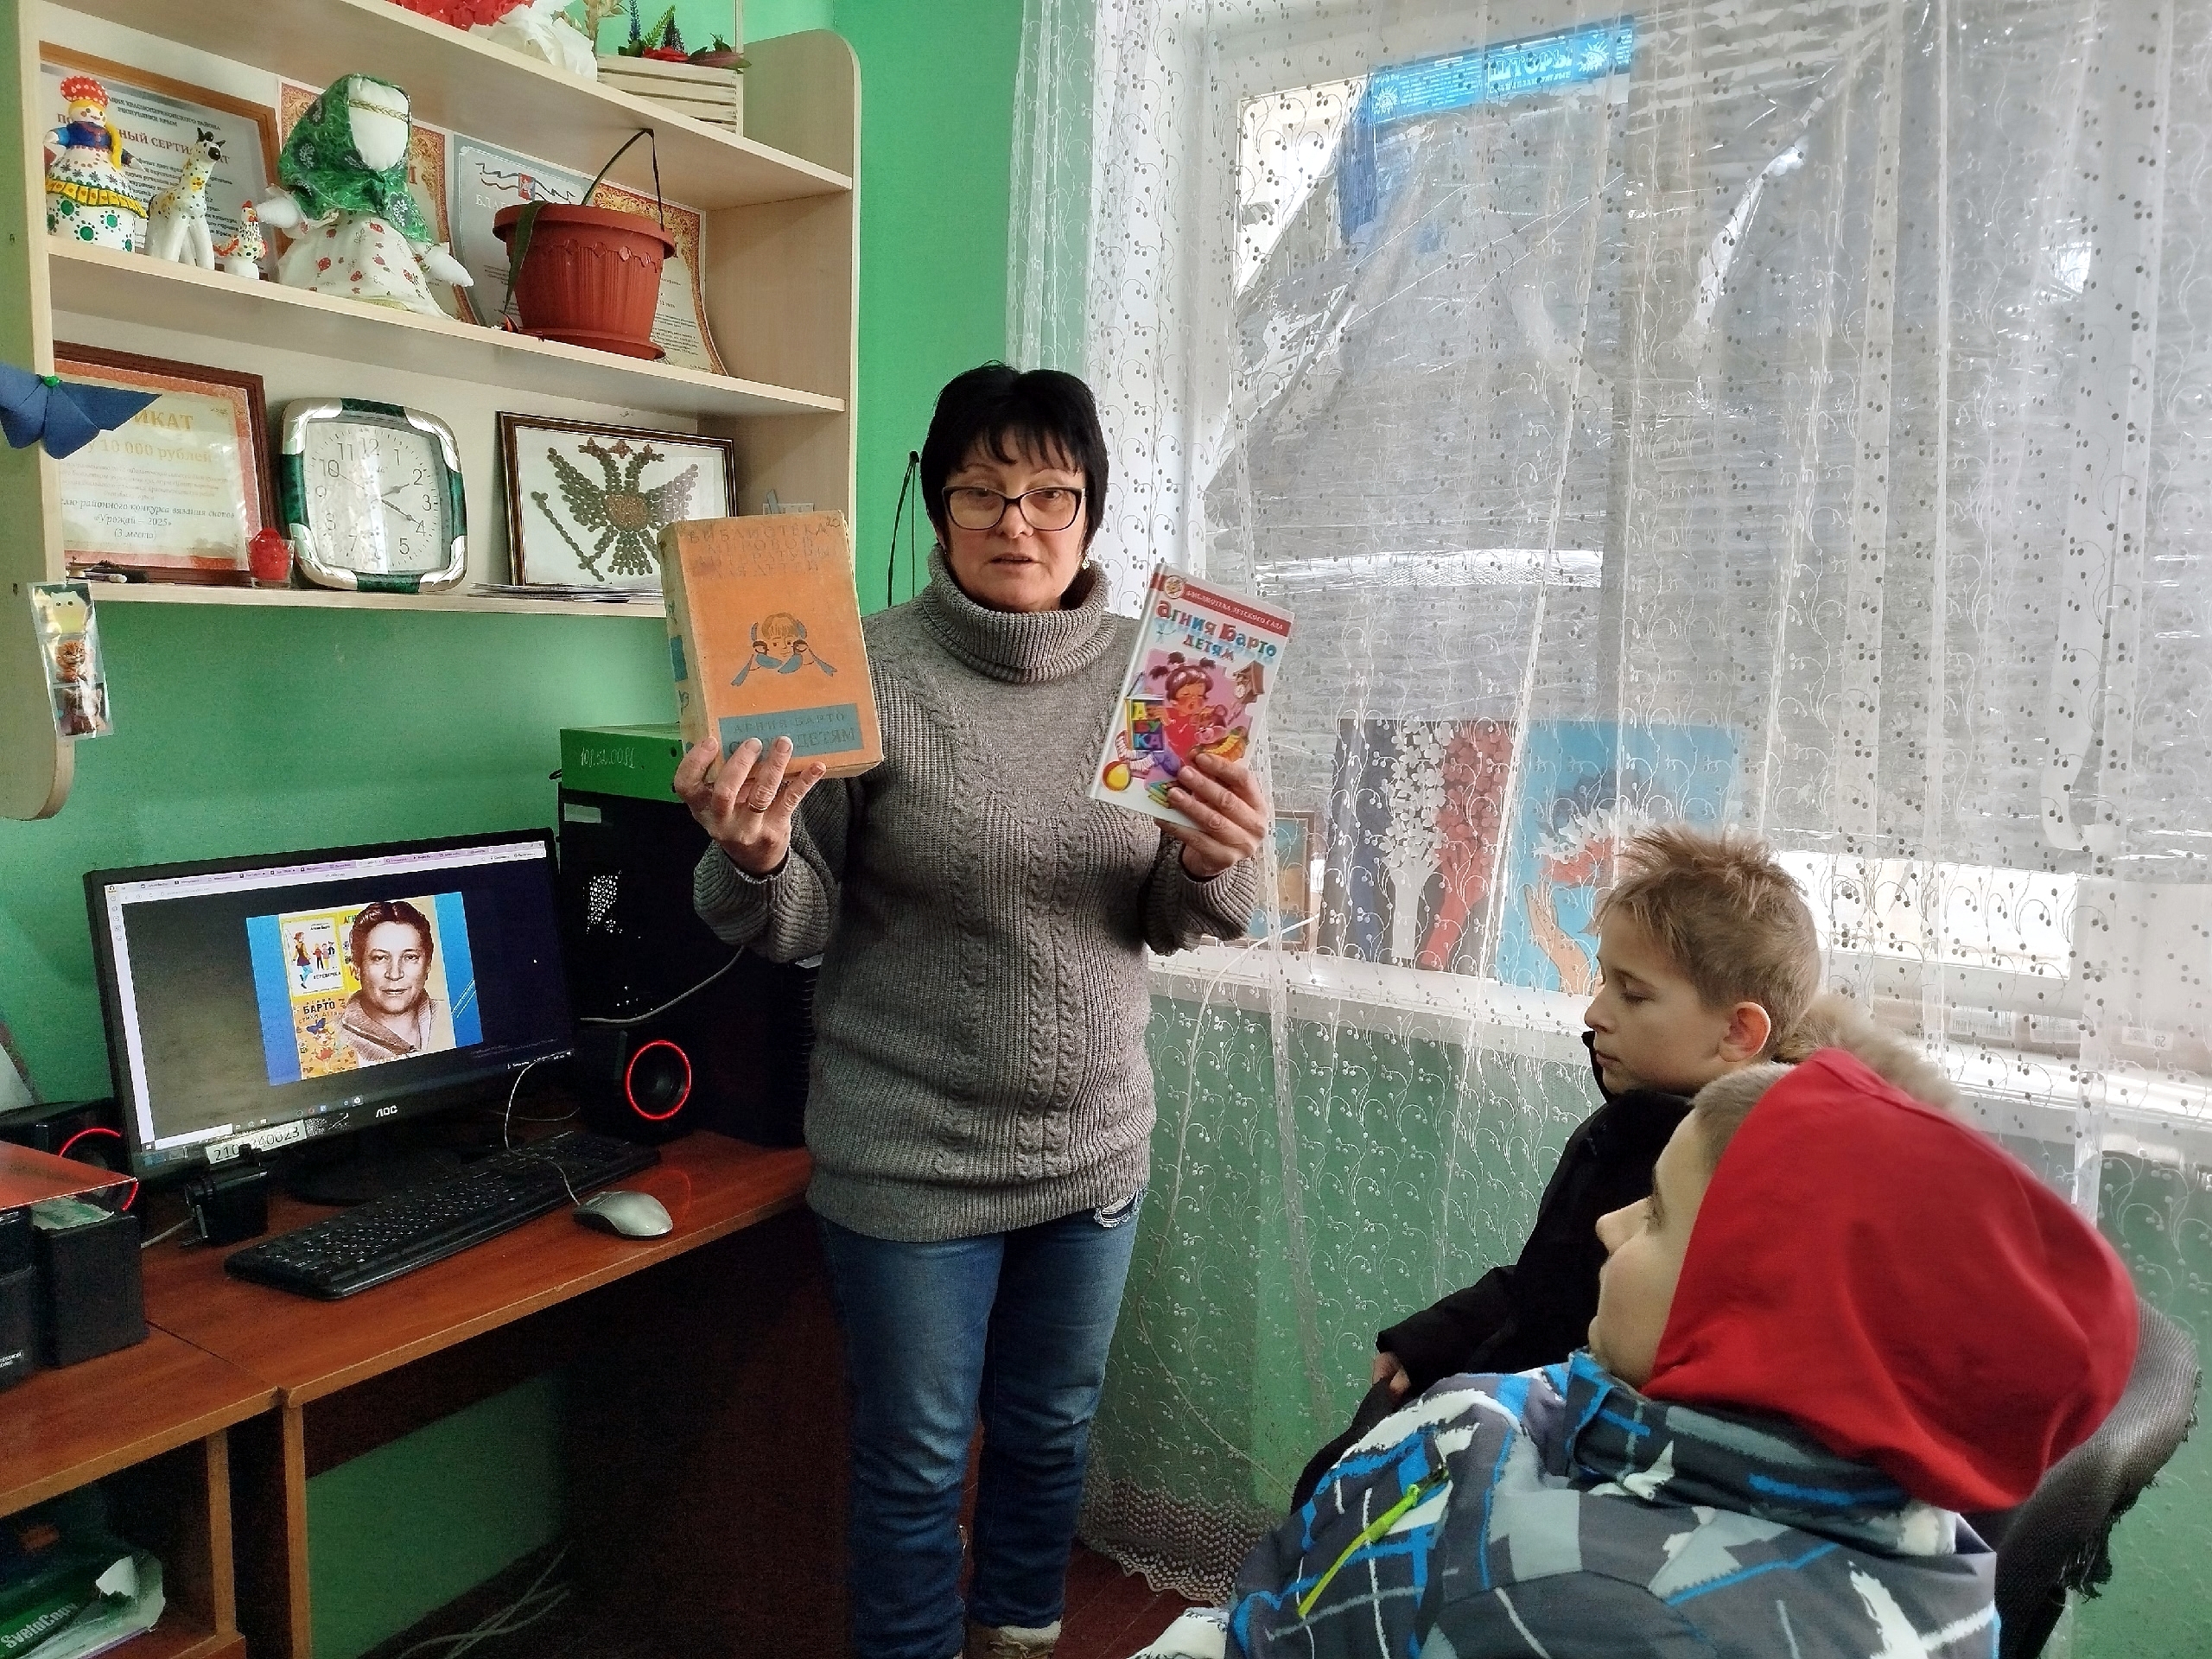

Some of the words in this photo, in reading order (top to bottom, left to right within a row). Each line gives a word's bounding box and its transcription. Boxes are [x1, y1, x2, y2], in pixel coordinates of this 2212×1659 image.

[99, 439, 120, 453] 10
[124, 442, 154, 455] 000
[157, 447, 213, 463] рублей
[337, 442, 353, 461] 11
[360, 437, 379, 454] 12
[393, 448, 401, 466] 1
[319, 459, 340, 477] 10
[412, 468, 423, 486] 2
[315, 486, 327, 502] 9
[422, 494, 432, 511] 3
[130, 504, 169, 515] конкурса
[325, 512, 336, 531] 8
[416, 519, 426, 537] 4
[689, 523, 828, 543] БИБЛИОТЕКА
[348, 534, 358, 552] 7
[398, 537, 410, 555] 5
[734, 719, 788, 734] АГНИЯ
[795, 711, 845, 727] БАРТО
[796, 728, 855, 749] ДЕТЯМ
[302, 1001, 335, 1014] БАРТО
[375, 1105, 397, 1118] AOC
